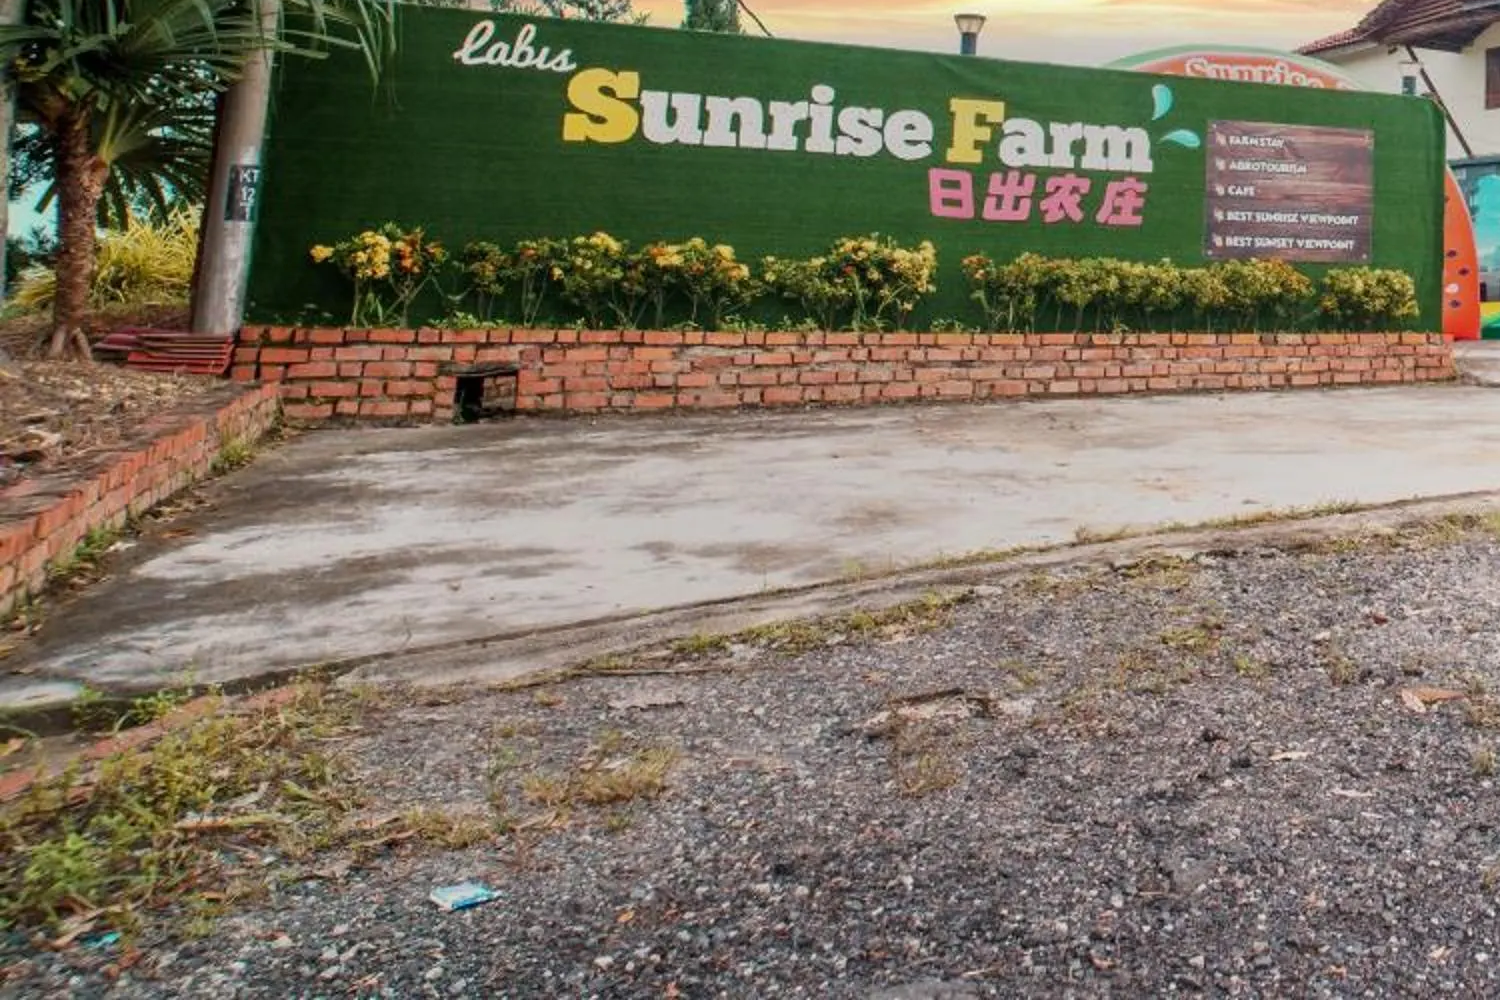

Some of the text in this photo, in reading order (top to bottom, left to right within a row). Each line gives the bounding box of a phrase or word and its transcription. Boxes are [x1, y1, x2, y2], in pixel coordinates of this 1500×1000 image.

[563, 67, 1153, 172] Sunrise Farm
[928, 167, 1148, 226] 日出农庄
[1227, 185, 1256, 197] CAFE
[1227, 210, 1253, 222] BEST
[1301, 213, 1359, 226] VIEWPOINT
[1225, 236, 1355, 251] BEST SUNSET VIEWPOINT
